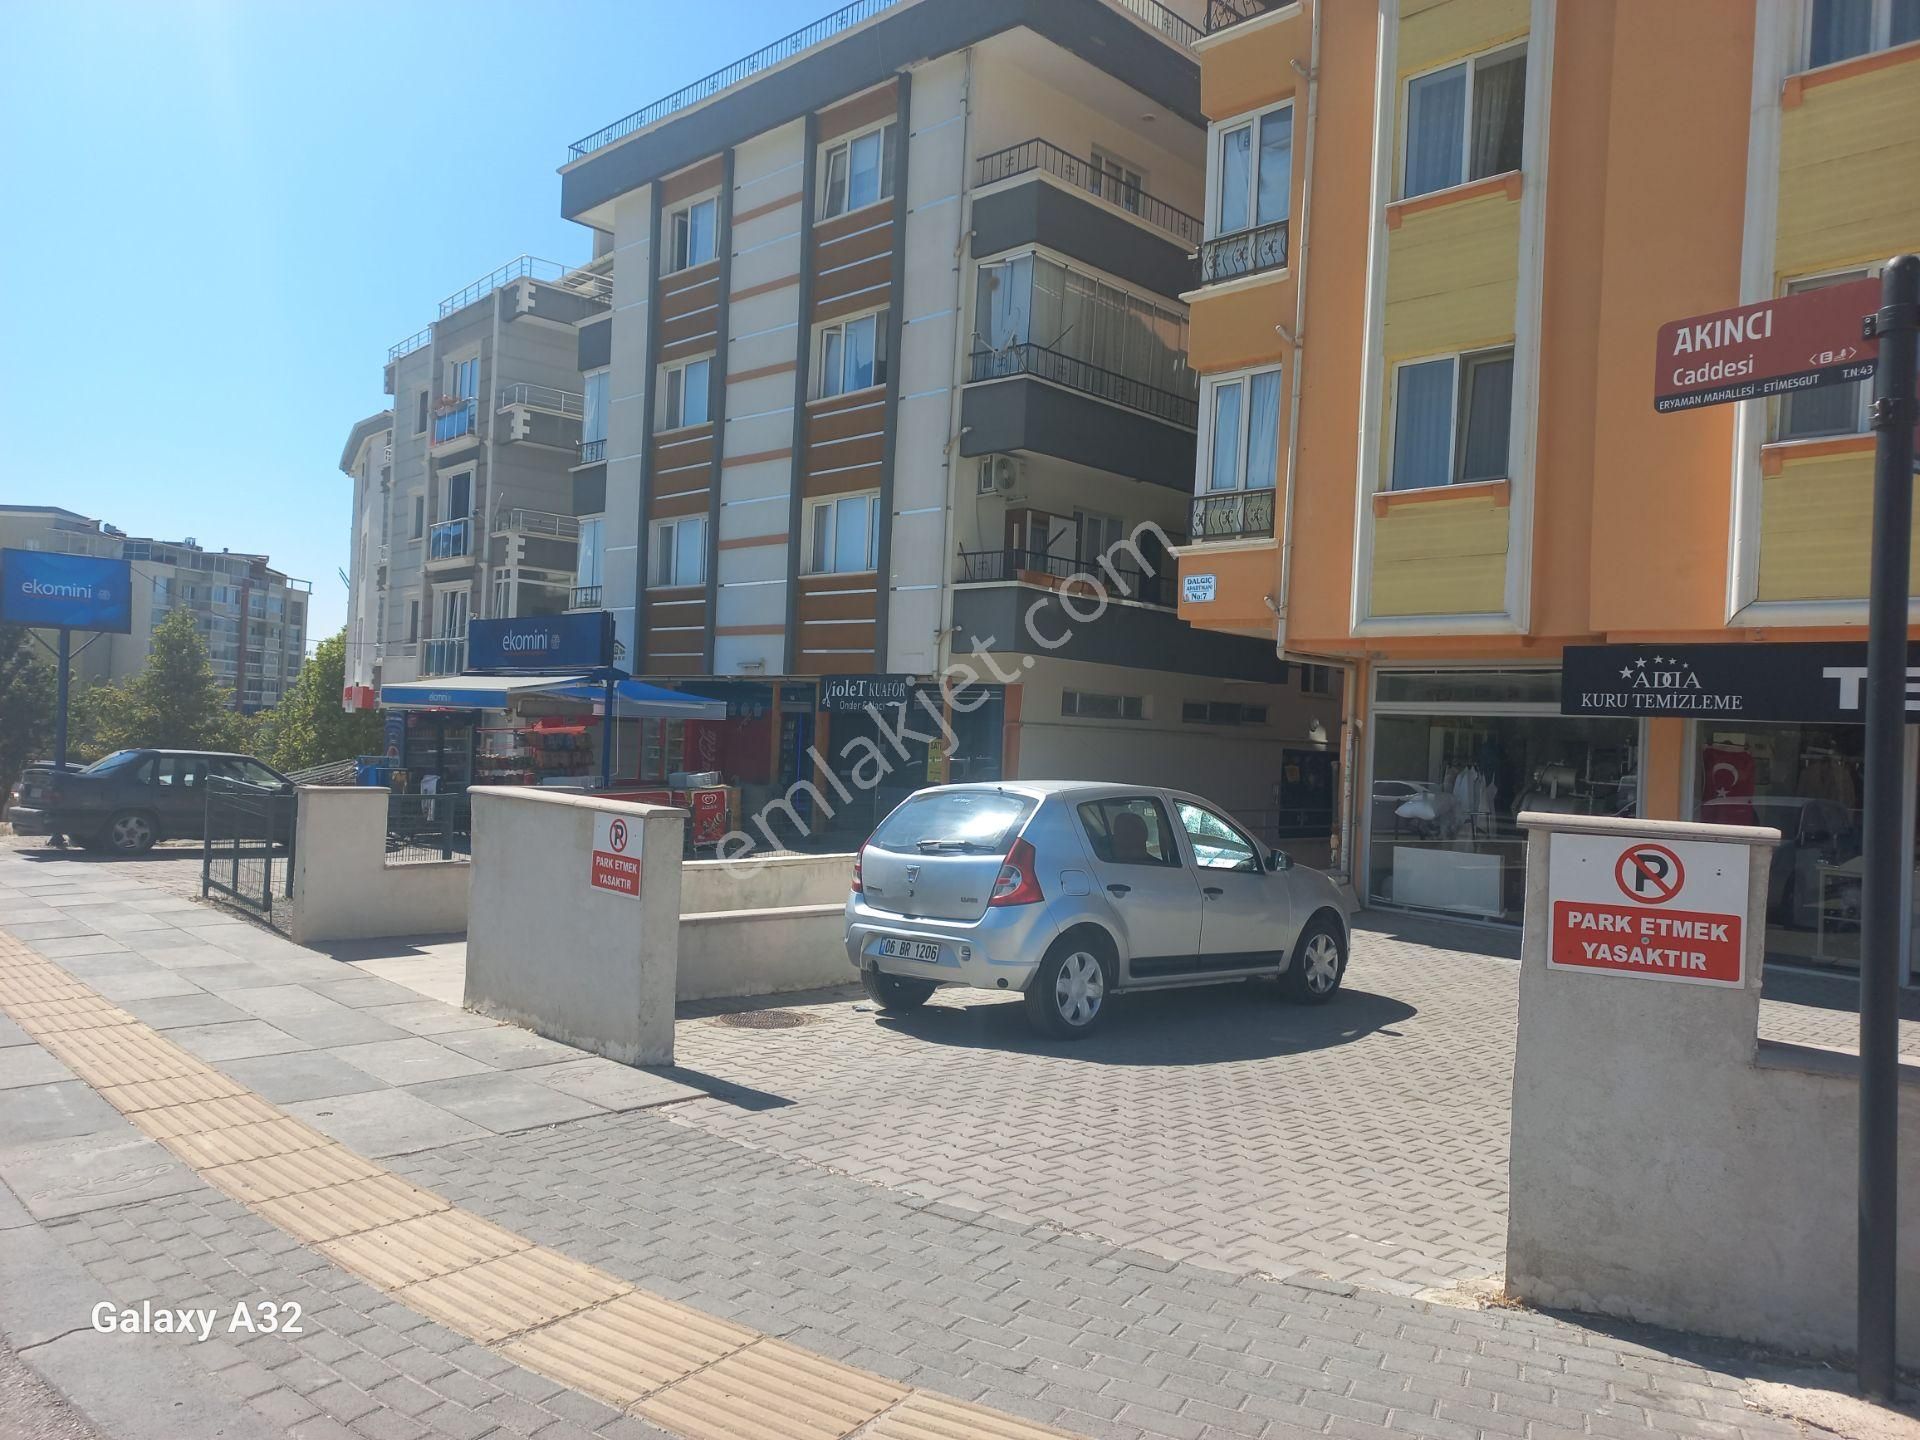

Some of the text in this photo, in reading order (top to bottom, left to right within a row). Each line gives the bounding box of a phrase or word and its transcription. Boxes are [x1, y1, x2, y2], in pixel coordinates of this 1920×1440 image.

[1673, 309, 1773, 356] AKINCI
[1673, 354, 1754, 386] Caddesi
[1659, 395, 1702, 411] ERYAMAN
[1703, 383, 1755, 404] MAHALLESİ
[1764, 374, 1820, 393] ETİMESGUT
[22, 578, 92, 599] ekomini
[502, 628, 548, 651] ekomini
[1581, 691, 1743, 710] KURU TEMİZLEME
[595, 855, 638, 875] PARK ETMEK
[598, 873, 632, 890] YASAKTIR
[1568, 911, 1729, 943] PARK ETMEK
[885, 938, 895, 954] 06
[900, 941, 911, 957] BR
[915, 943, 938, 960] 1206
[1581, 941, 1707, 971] YASAKTIR
